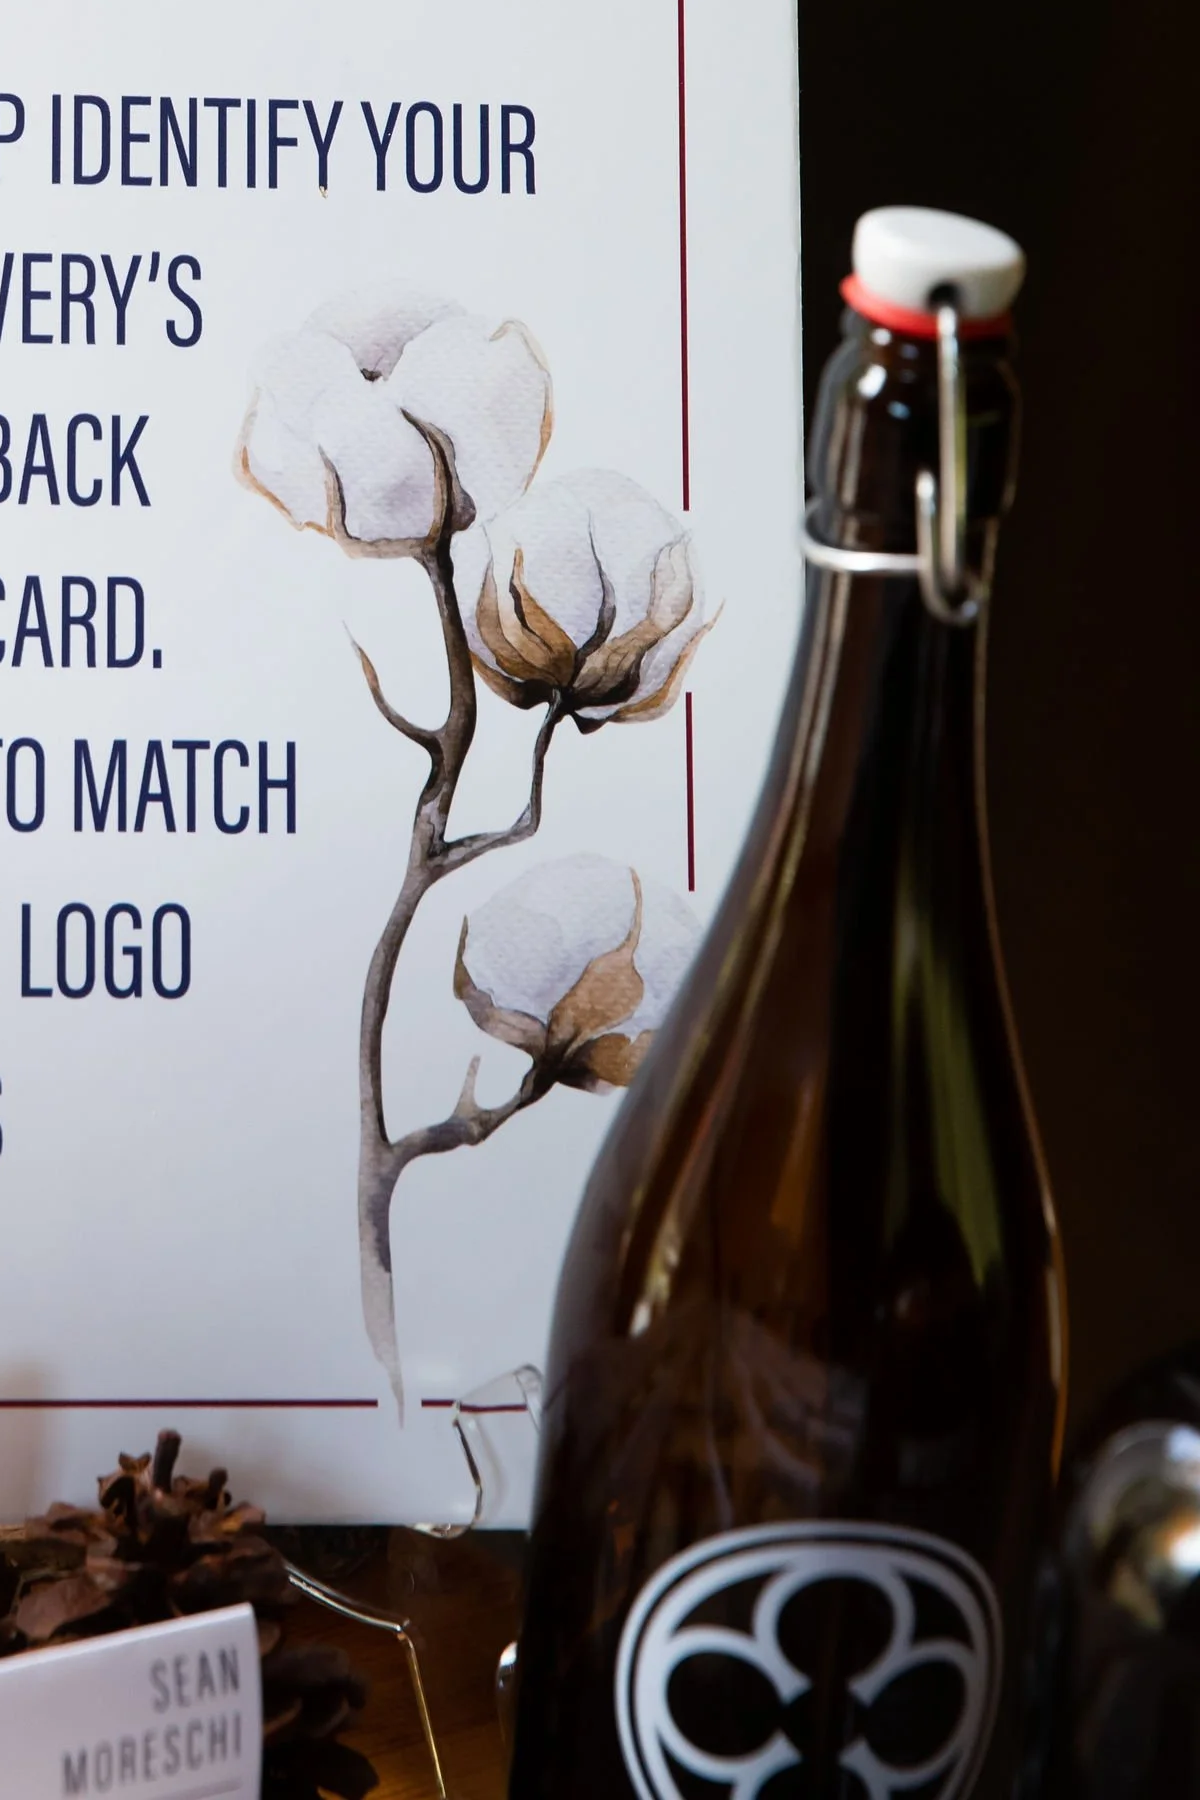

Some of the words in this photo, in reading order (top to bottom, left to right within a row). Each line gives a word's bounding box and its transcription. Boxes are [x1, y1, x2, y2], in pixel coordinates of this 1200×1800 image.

[50, 93, 345, 192] IDENTIFY
[359, 100, 537, 196] YOUR
[72, 738, 298, 836] MATCH
[20, 901, 192, 1001] LOGO
[150, 1645, 241, 1714] SEAN
[61, 1711, 242, 1794] MORESCHI
